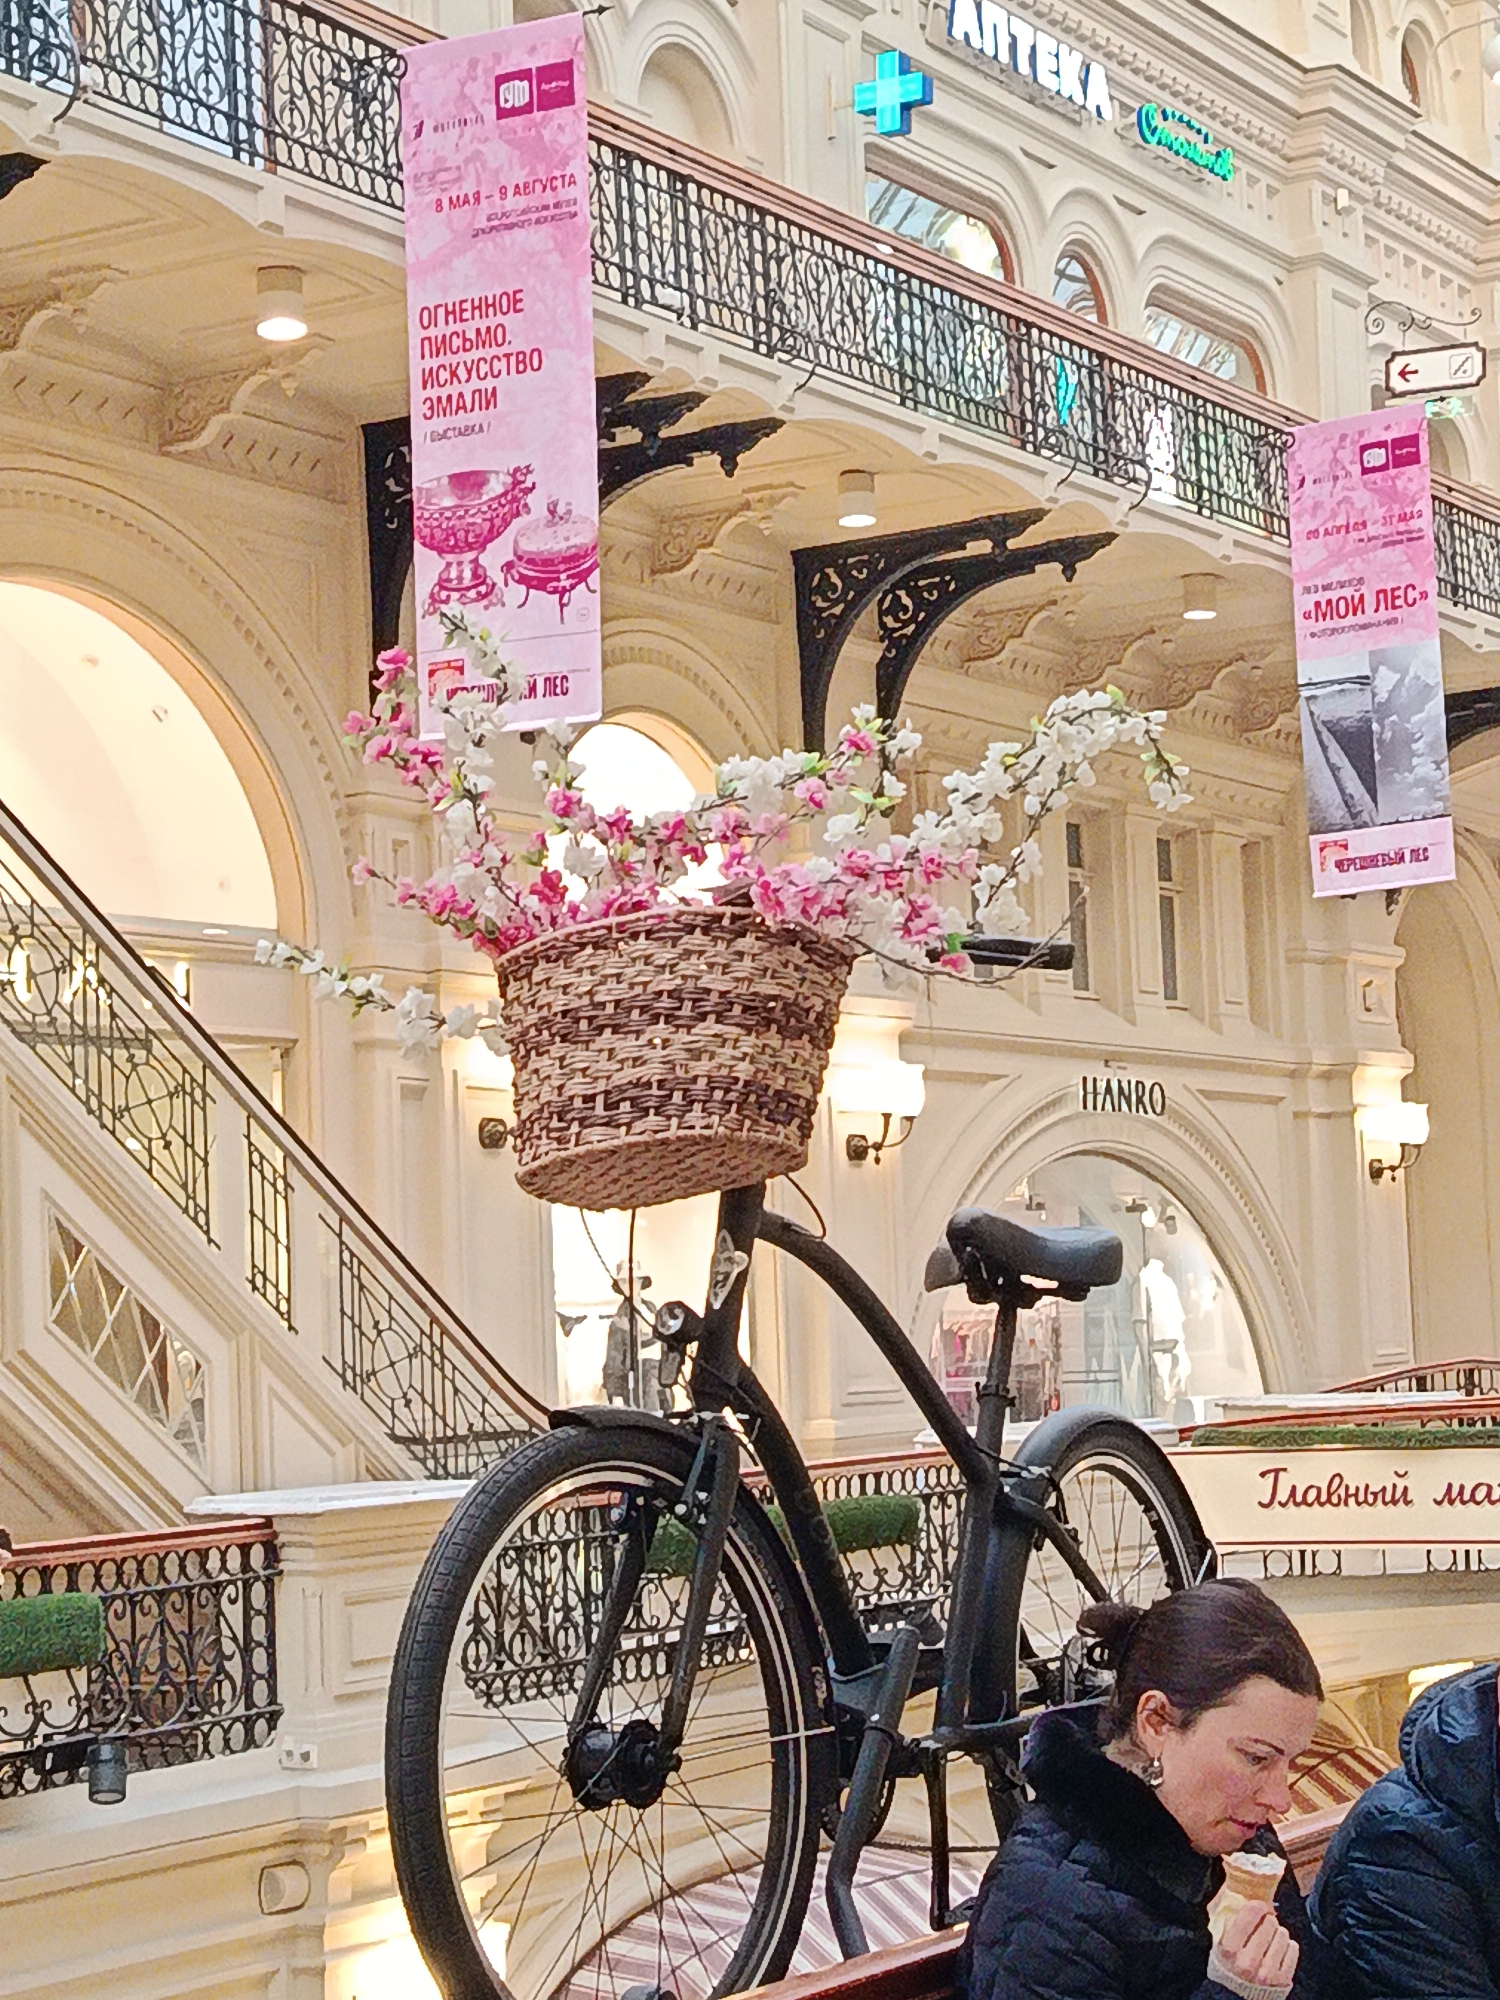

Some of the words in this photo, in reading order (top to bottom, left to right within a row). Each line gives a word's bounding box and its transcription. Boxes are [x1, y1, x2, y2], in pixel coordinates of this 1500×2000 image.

[949, 0, 1113, 121] АПТЕКА
[435, 198, 444, 213] 8
[448, 189, 481, 211] МАЯ
[499, 185, 508, 201] 9
[512, 173, 577, 198] АВГУСТА
[419, 289, 524, 331] ОГНЕННОЕ
[421, 347, 543, 391] ИСКУССТВО
[422, 386, 498, 421] ЭМАЛИ
[1302, 587, 1365, 623] «МОЙ
[1373, 583, 1428, 613] ЛЕС»
[542, 675, 569, 698] ЛЕС
[1082, 1075, 1166, 1117] HANRO
[1257, 1467, 1414, 1508] Главный
[1432, 1481, 1500, 1507] ма
